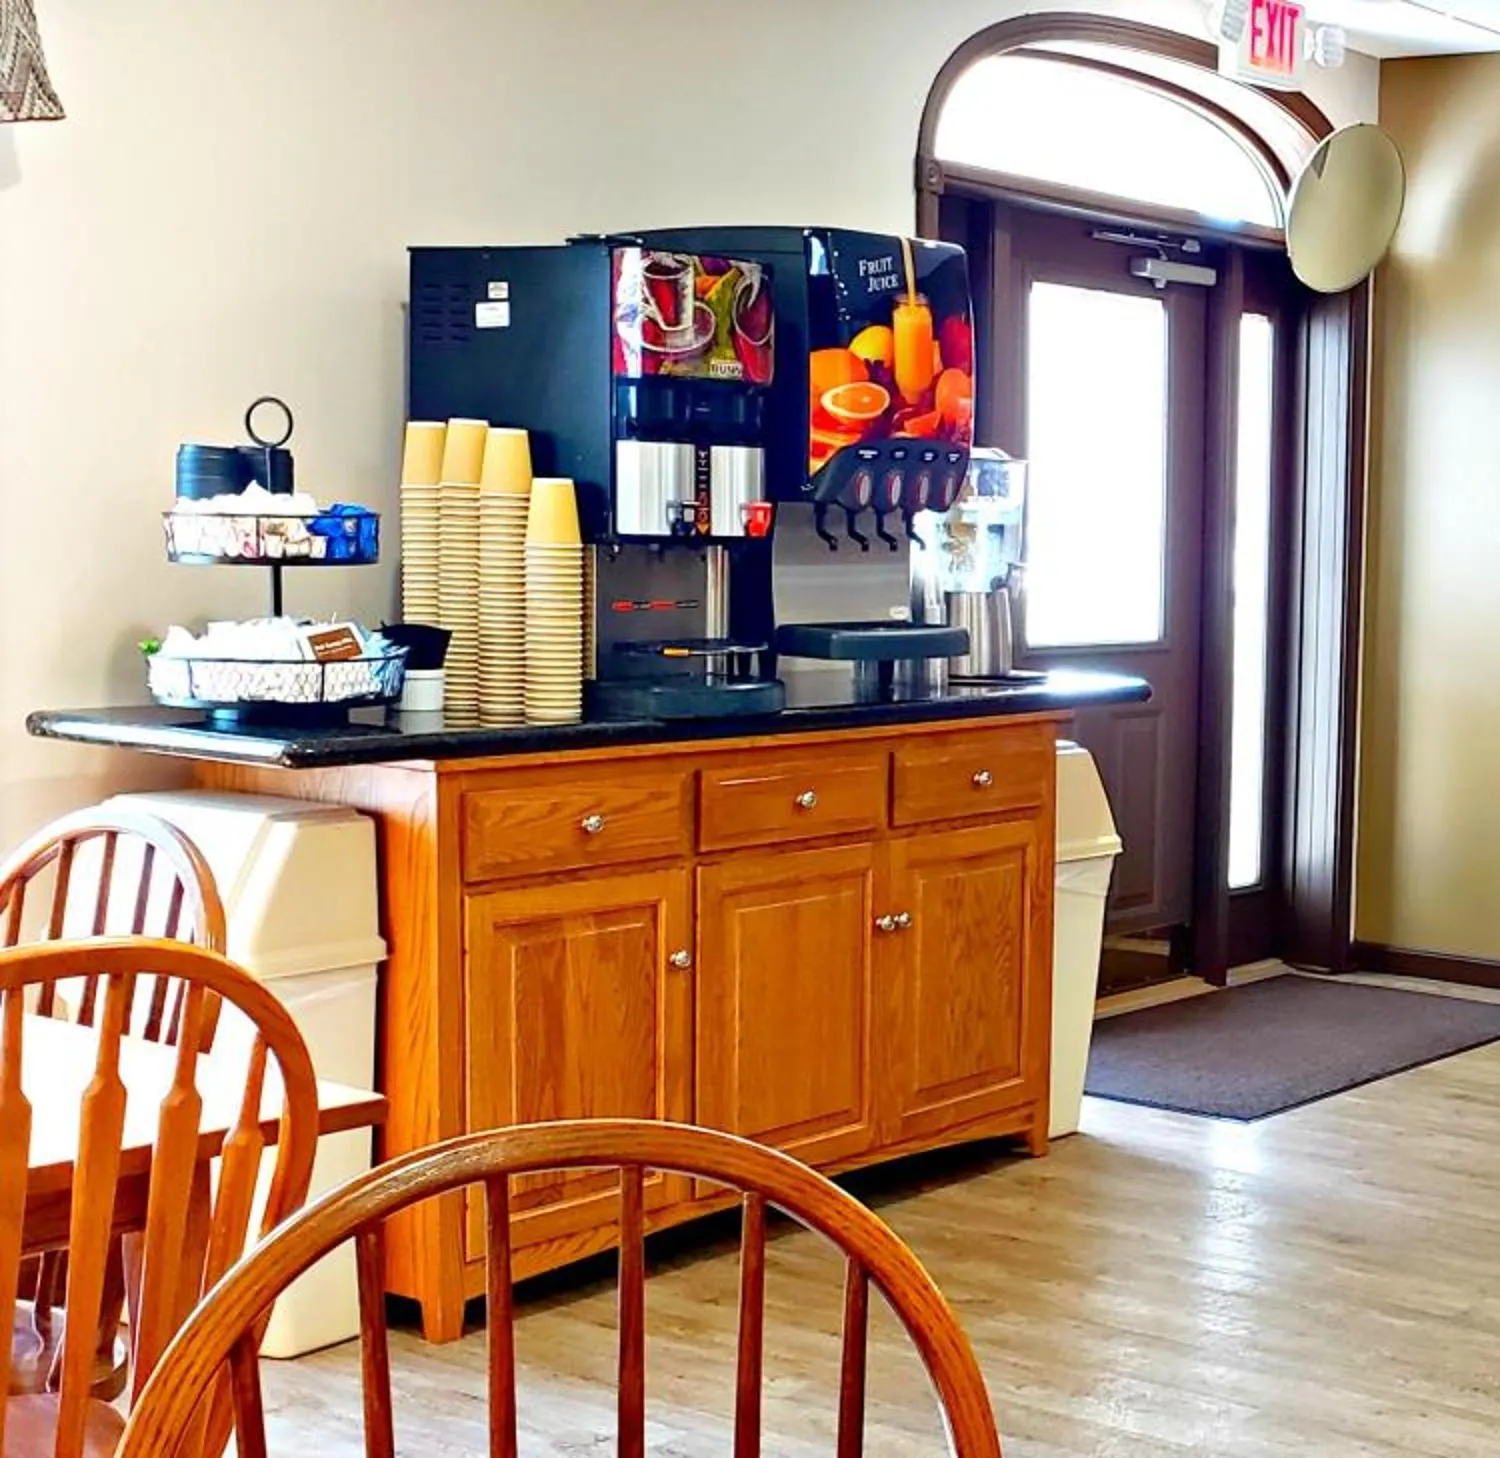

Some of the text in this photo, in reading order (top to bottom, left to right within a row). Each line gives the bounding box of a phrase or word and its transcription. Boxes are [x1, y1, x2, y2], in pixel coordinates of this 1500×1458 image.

[1249, 0, 1299, 75] EXIT
[858, 256, 893, 277] FRUIT
[867, 274, 899, 292] JUICE
